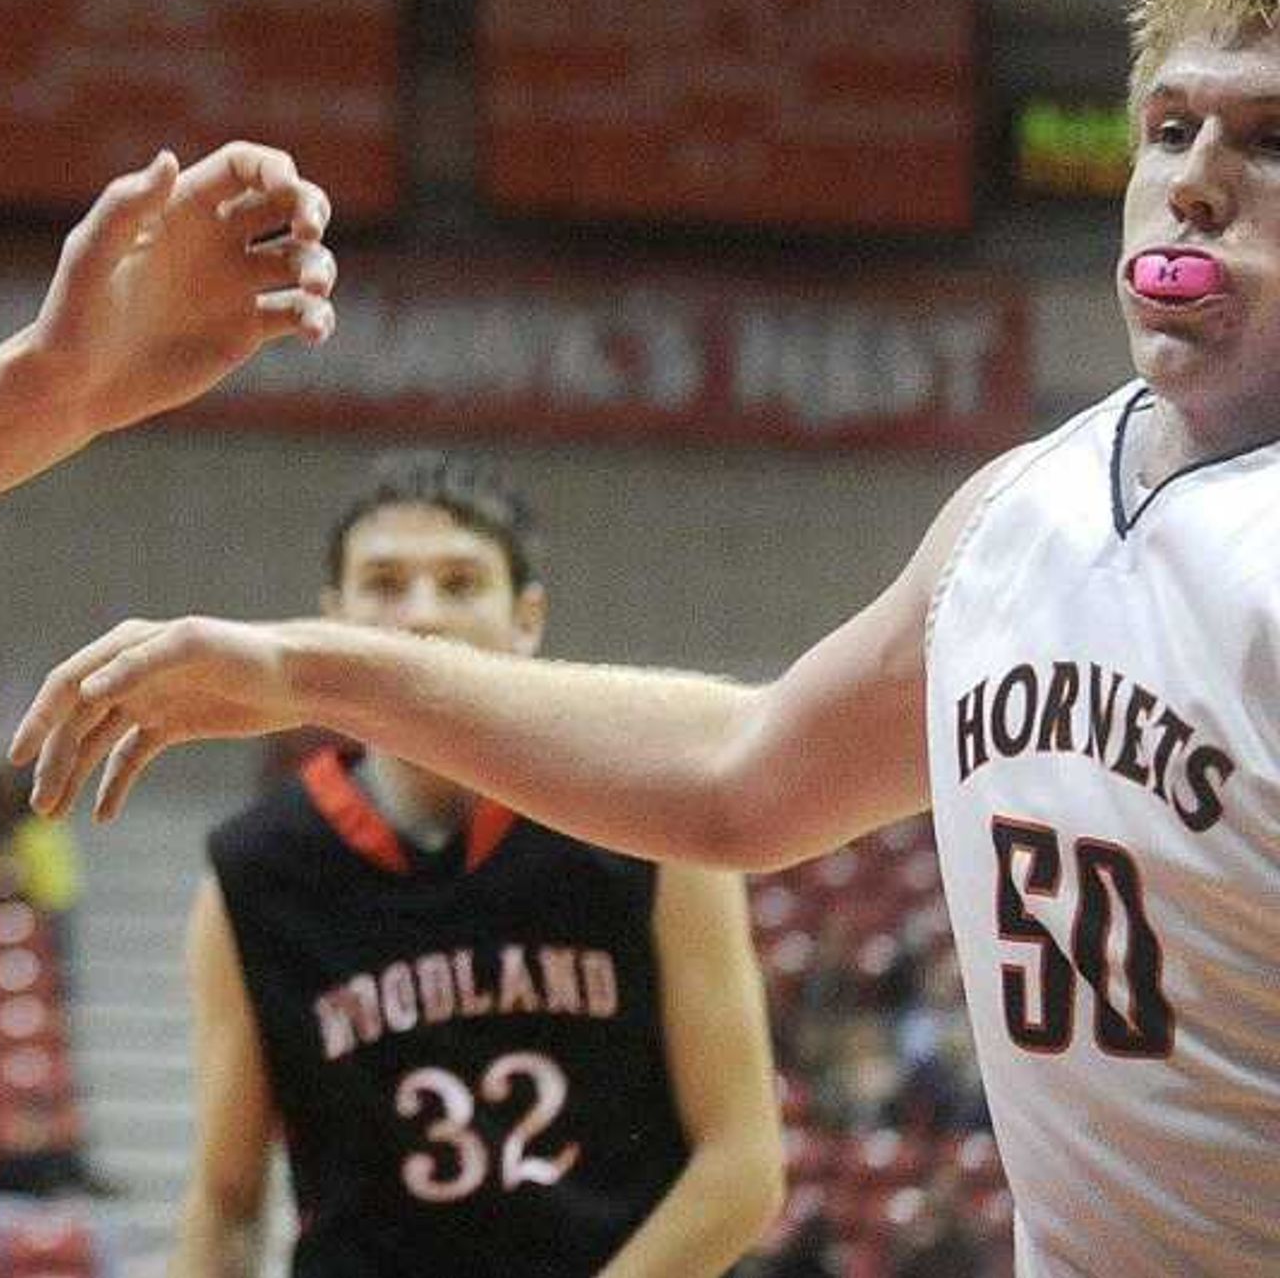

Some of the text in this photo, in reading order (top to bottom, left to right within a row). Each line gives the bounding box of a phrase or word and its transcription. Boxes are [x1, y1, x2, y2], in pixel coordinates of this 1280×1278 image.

[955, 660, 1236, 834] HORNETS
[313, 944, 619, 1062] WOODLAND
[990, 813, 1177, 1061] 50
[394, 1050, 583, 1204] 32
